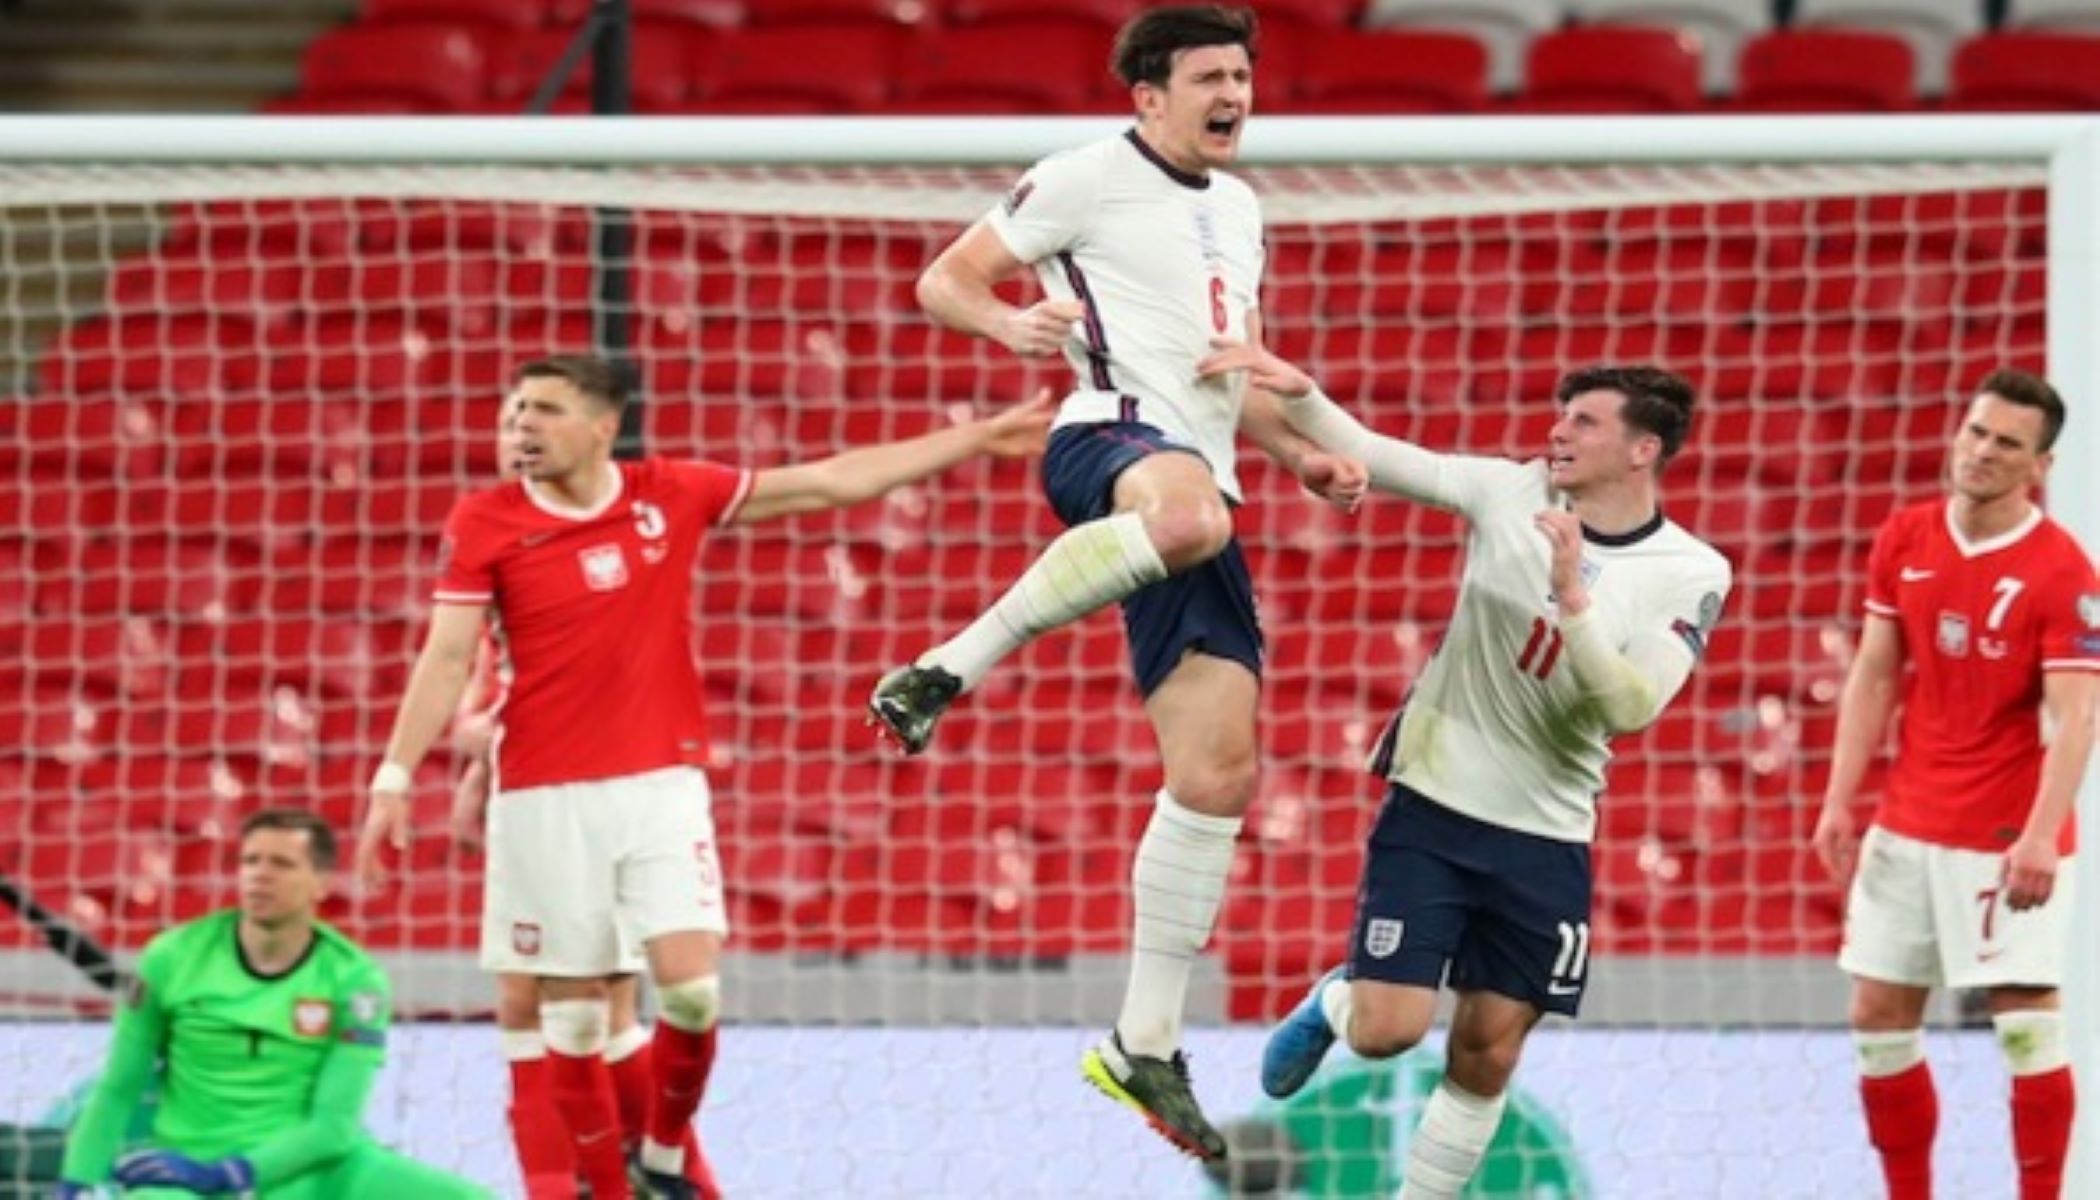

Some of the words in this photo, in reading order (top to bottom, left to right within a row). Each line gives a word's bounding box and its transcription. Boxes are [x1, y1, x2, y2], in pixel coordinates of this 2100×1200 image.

[1209, 276, 1228, 334] 6
[1987, 577, 2025, 630] 7
[1517, 615, 1563, 680] 11
[1976, 890, 1999, 941] 7
[1551, 921, 1589, 979] 11
